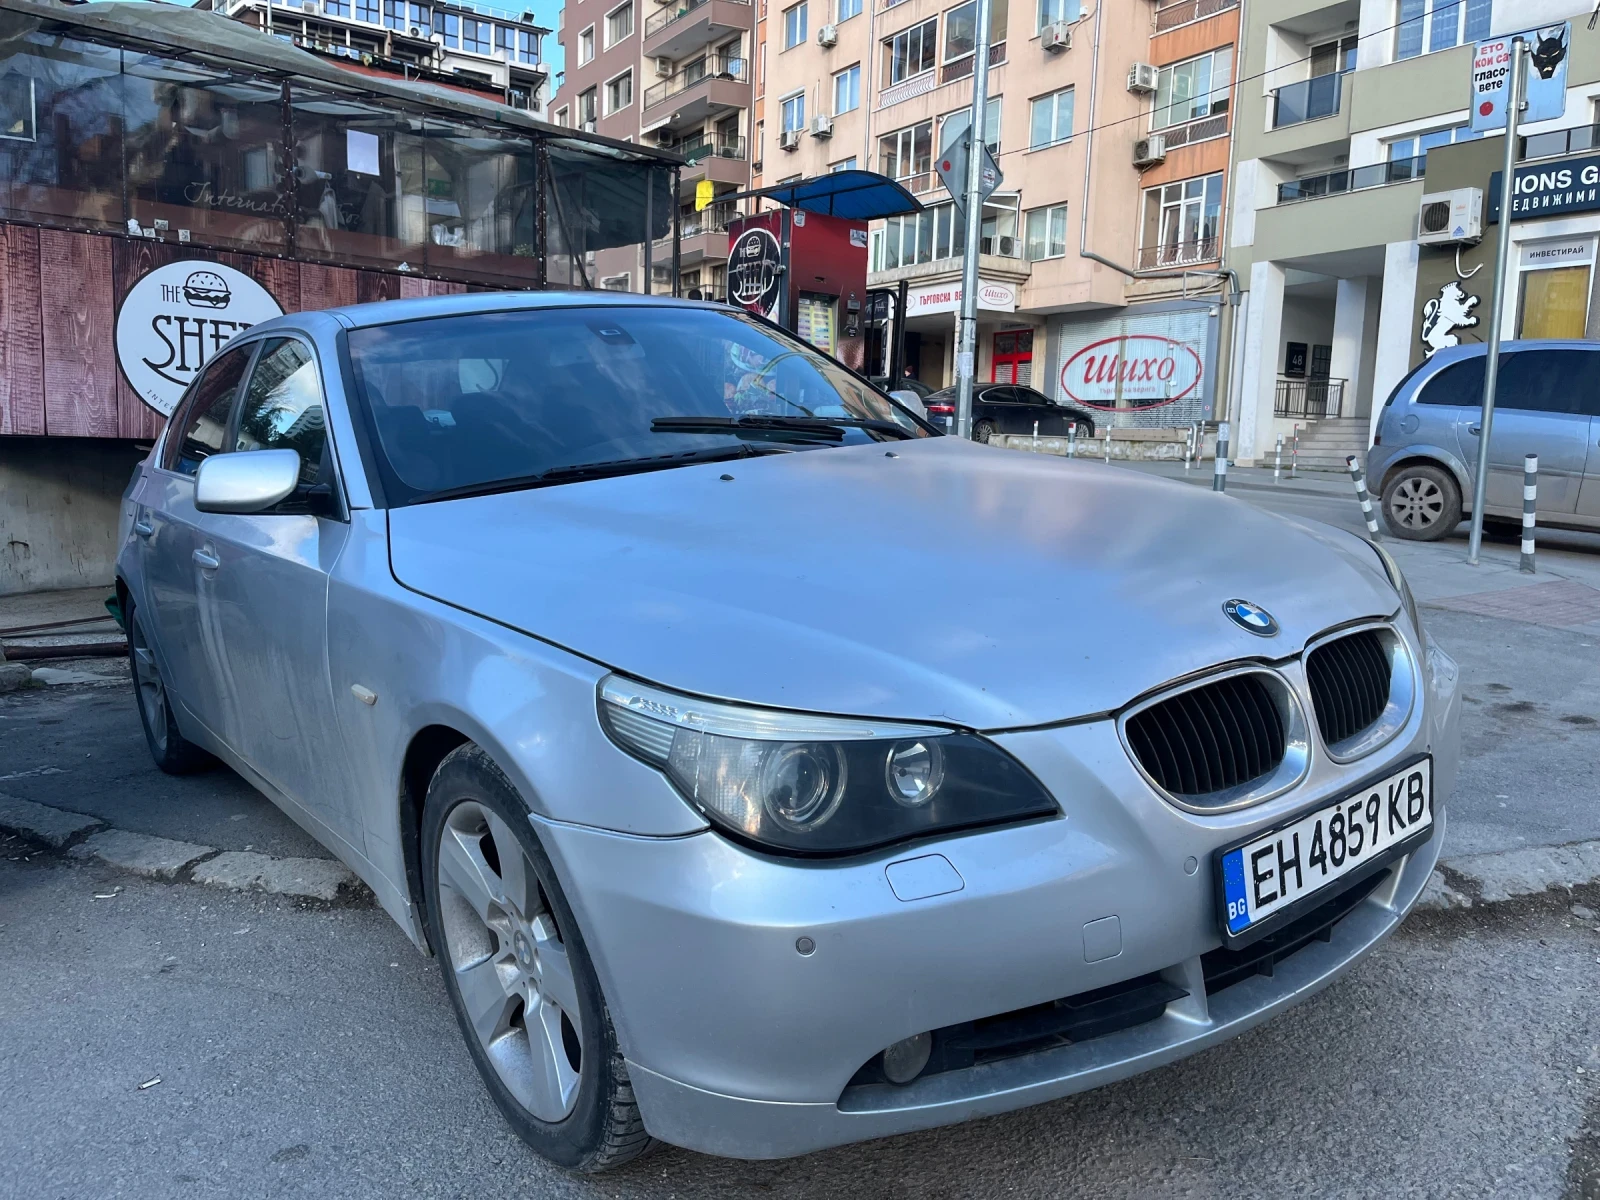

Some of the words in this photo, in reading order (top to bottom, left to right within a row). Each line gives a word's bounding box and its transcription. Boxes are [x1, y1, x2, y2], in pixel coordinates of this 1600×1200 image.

[1480, 43, 1504, 55] ЕТО
[1474, 67, 1510, 82] гласо-
[1479, 80, 1503, 93] вете
[1511, 169, 1572, 196] IONS
[1581, 165, 1600, 185] G
[184, 181, 288, 214] Internati
[1512, 188, 1596, 212] ЕДВИЖИМИ
[1529, 245, 1584, 259] ИНВЕСТИРАЙ
[160, 284, 181, 303] THE
[919, 292, 951, 306] ТЪРГОВСКА
[954, 290, 963, 302] ВЕ
[984, 289, 1009, 299] Шихо
[142, 314, 255, 387] SHE
[1083, 354, 1175, 384] Шихо
[1292, 355, 1303, 366] 48
[1228, 898, 1246, 921] BG
